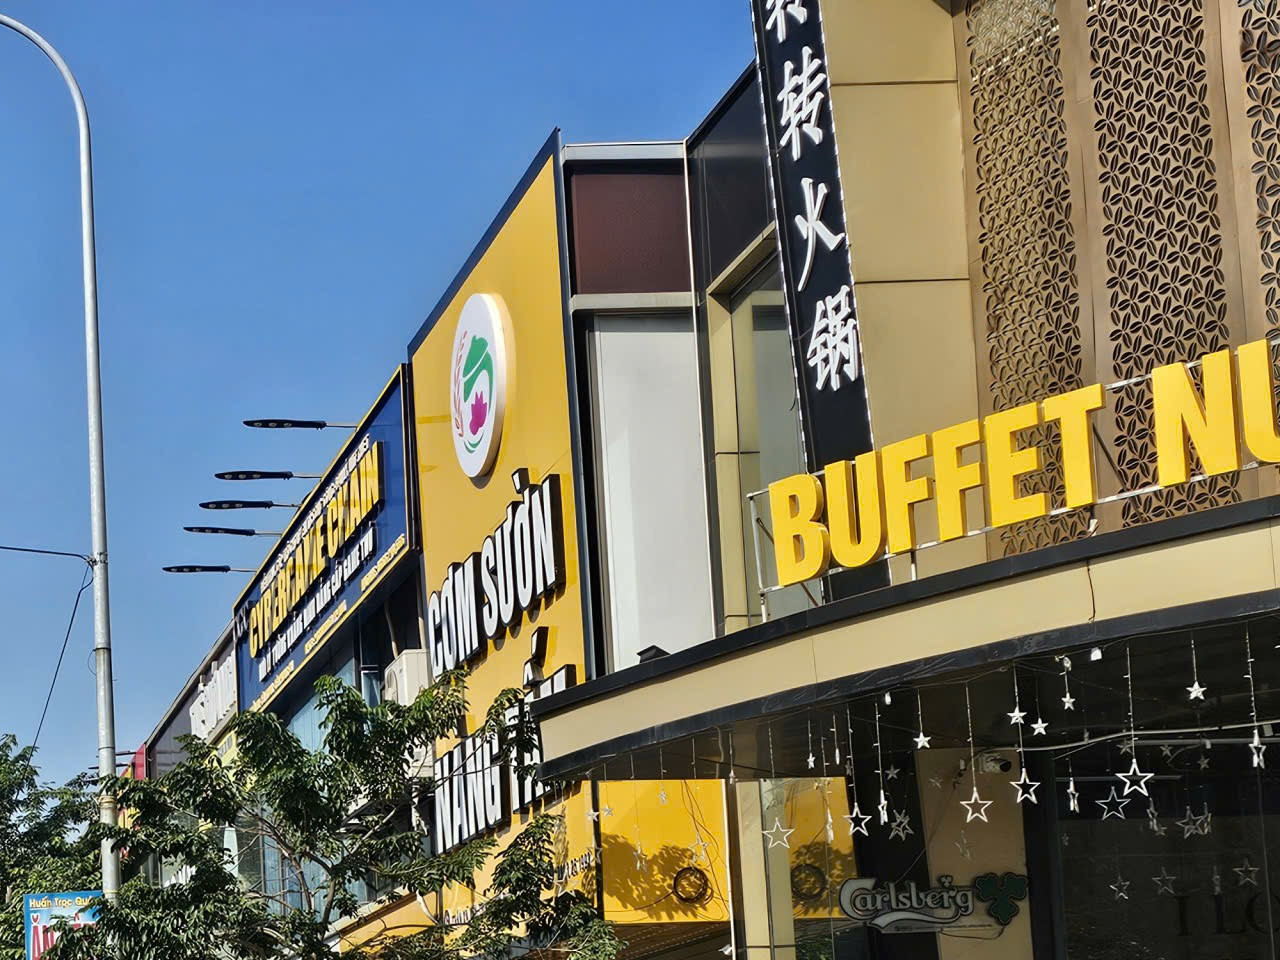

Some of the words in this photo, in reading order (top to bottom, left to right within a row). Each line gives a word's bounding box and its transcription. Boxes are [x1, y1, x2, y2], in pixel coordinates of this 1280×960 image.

[327, 440, 381, 560] CHAIN
[768, 383, 1104, 587] BUFFET
[428, 553, 482, 683] CƠM
[481, 470, 560, 638] SƯỜN
[839, 876, 974, 924] Carlsberg
